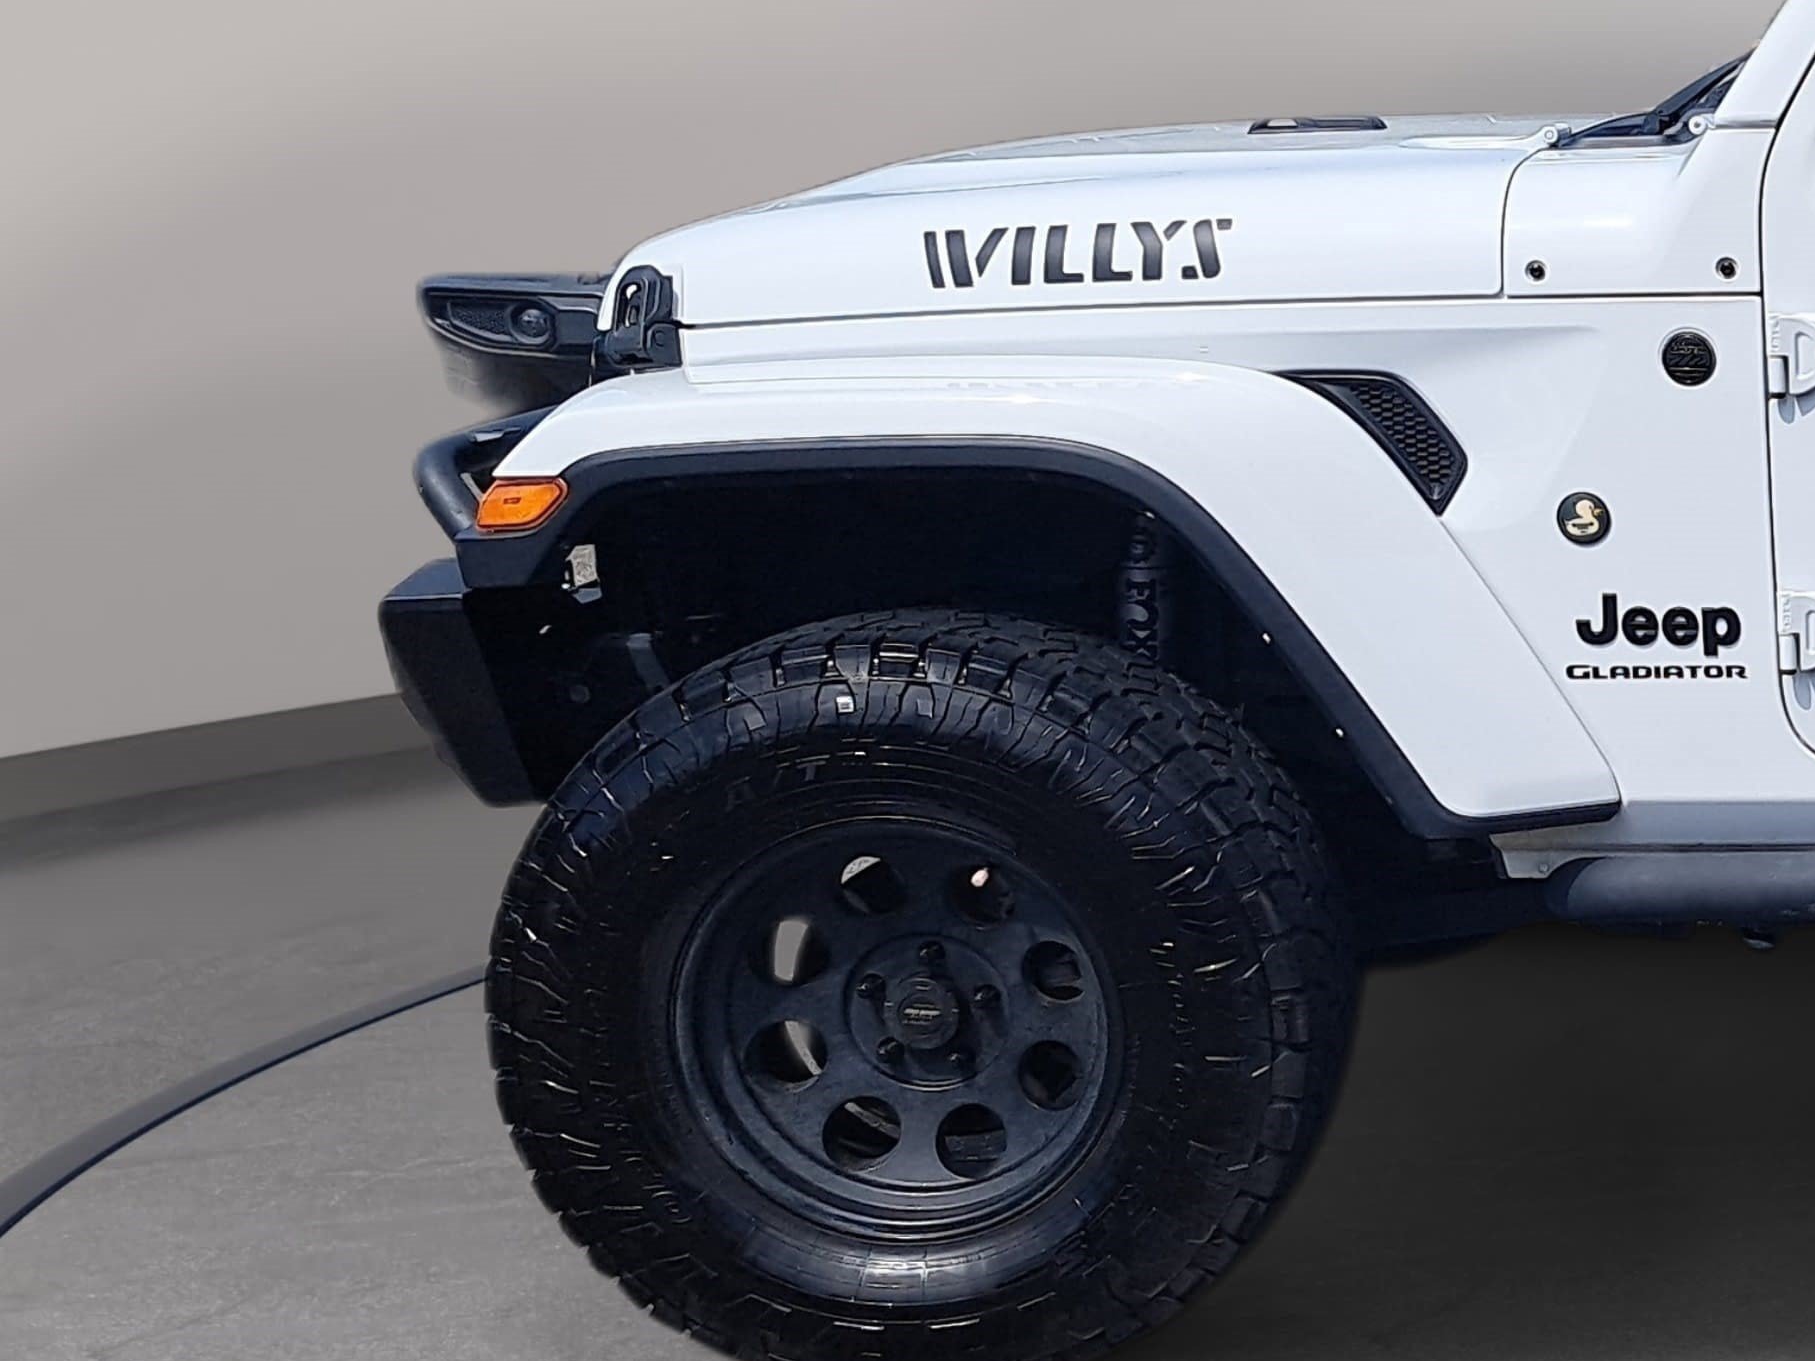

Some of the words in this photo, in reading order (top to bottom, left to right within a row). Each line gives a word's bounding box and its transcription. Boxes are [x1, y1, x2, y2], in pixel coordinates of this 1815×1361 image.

[924, 218, 1233, 289] WILLYS
[1126, 578, 1159, 660] FOX
[1575, 592, 1742, 657] Jeep
[1565, 664, 1748, 680] GLADIATOR
